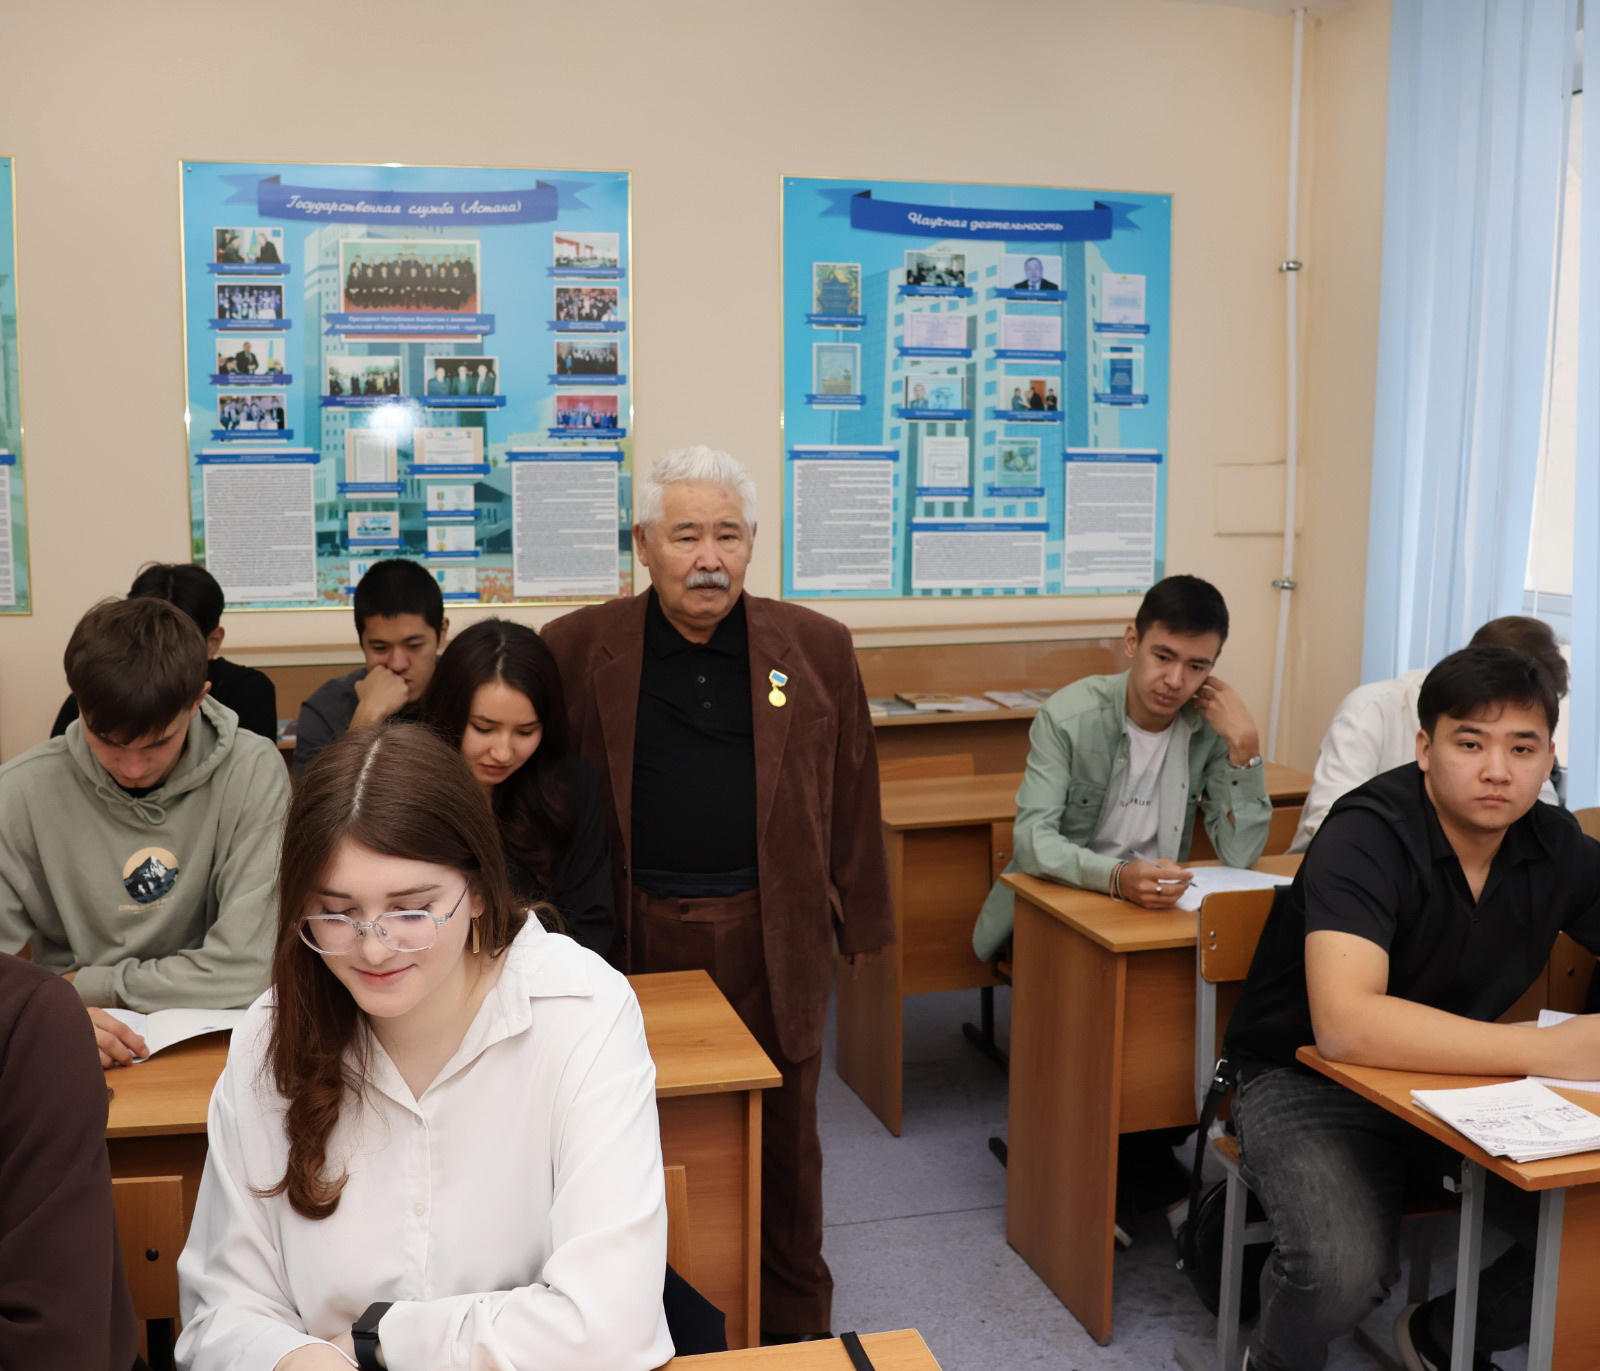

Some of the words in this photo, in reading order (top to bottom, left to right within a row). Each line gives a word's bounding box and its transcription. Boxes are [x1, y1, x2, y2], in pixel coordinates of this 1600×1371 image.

[286, 195, 400, 215] Государственная
[408, 203, 454, 219] служба
[461, 199, 522, 215] (Астана)
[907, 212, 967, 229] Научная
[969, 220, 1063, 231] деятельность
